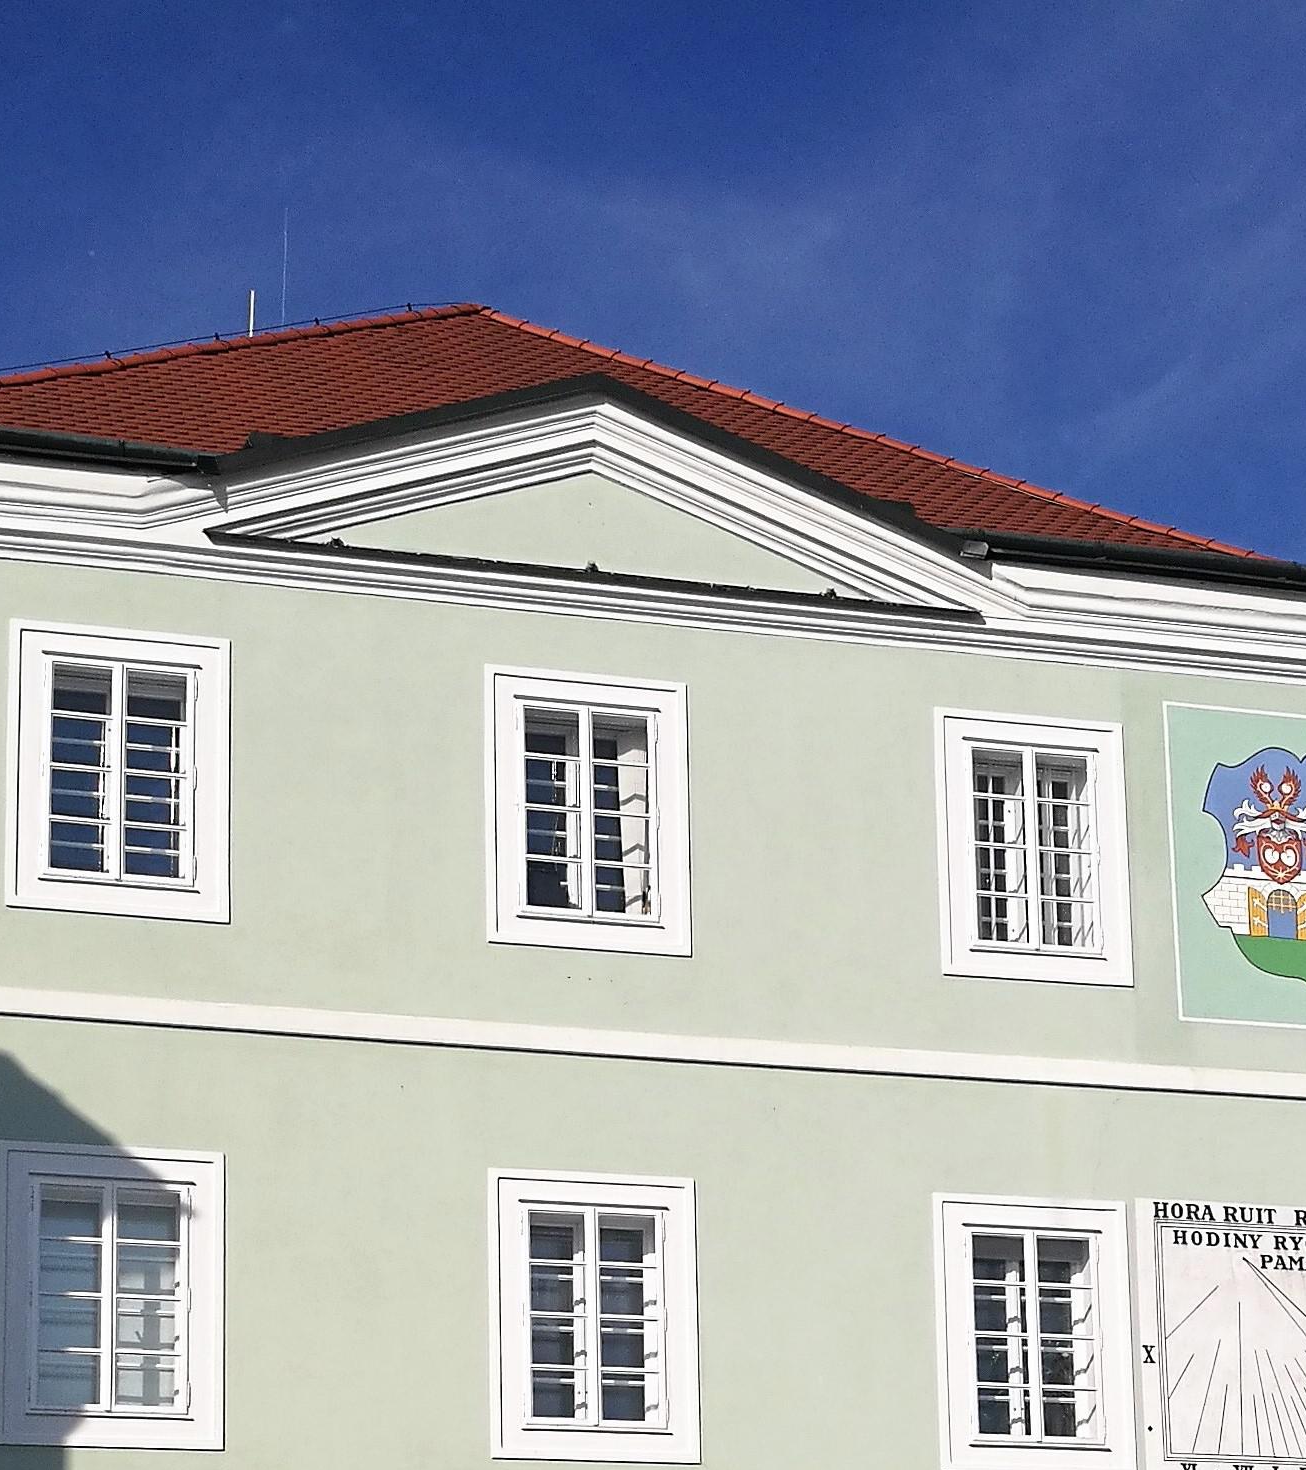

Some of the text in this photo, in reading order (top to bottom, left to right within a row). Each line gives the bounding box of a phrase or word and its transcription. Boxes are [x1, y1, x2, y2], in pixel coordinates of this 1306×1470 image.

[1153, 1201, 1216, 1221] HORA
[1223, 1205, 1277, 1225] RUIT
[1173, 1229, 1263, 1249] HODINY
[1142, 1345, 1156, 1363] X
